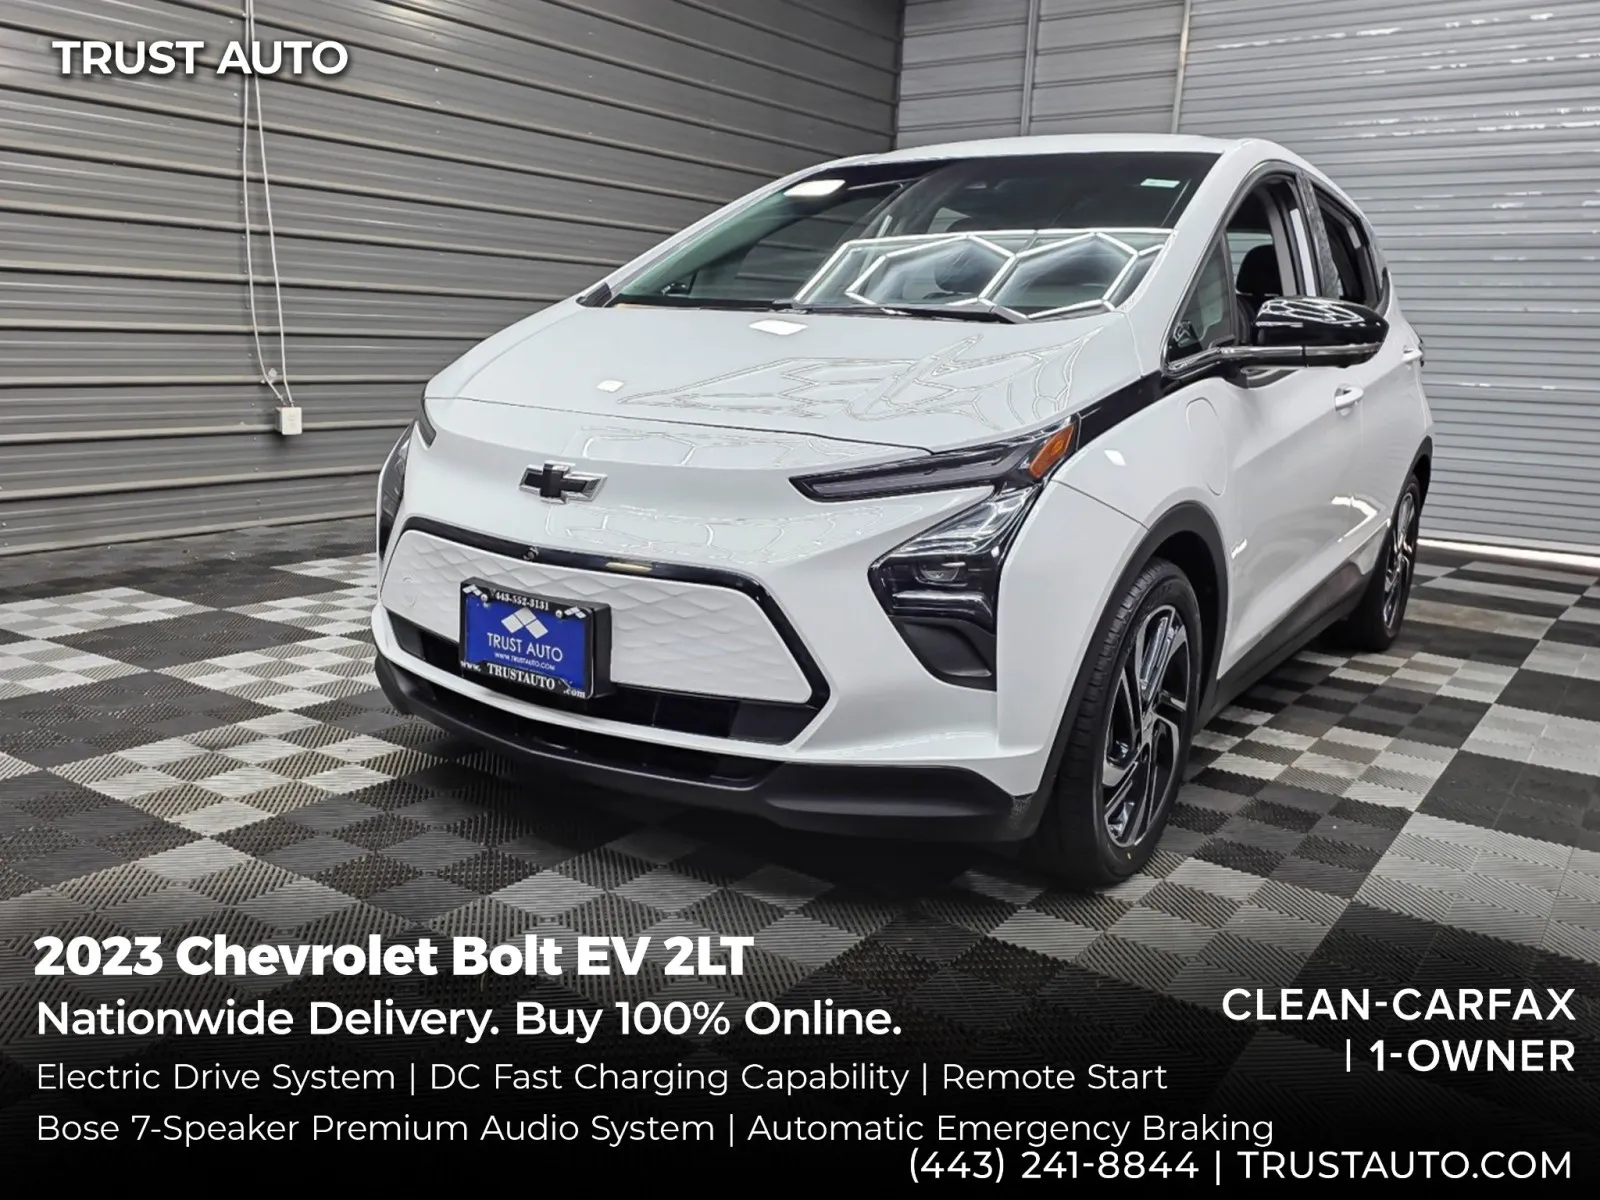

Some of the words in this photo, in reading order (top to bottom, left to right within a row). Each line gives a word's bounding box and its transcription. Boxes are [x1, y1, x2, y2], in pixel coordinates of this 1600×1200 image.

[495, 591, 549, 611] 443-552-3131
[487, 632, 522, 653] TRUST
[526, 642, 563, 662] AUTO
[487, 662, 555, 690] TRUSTAUTO
